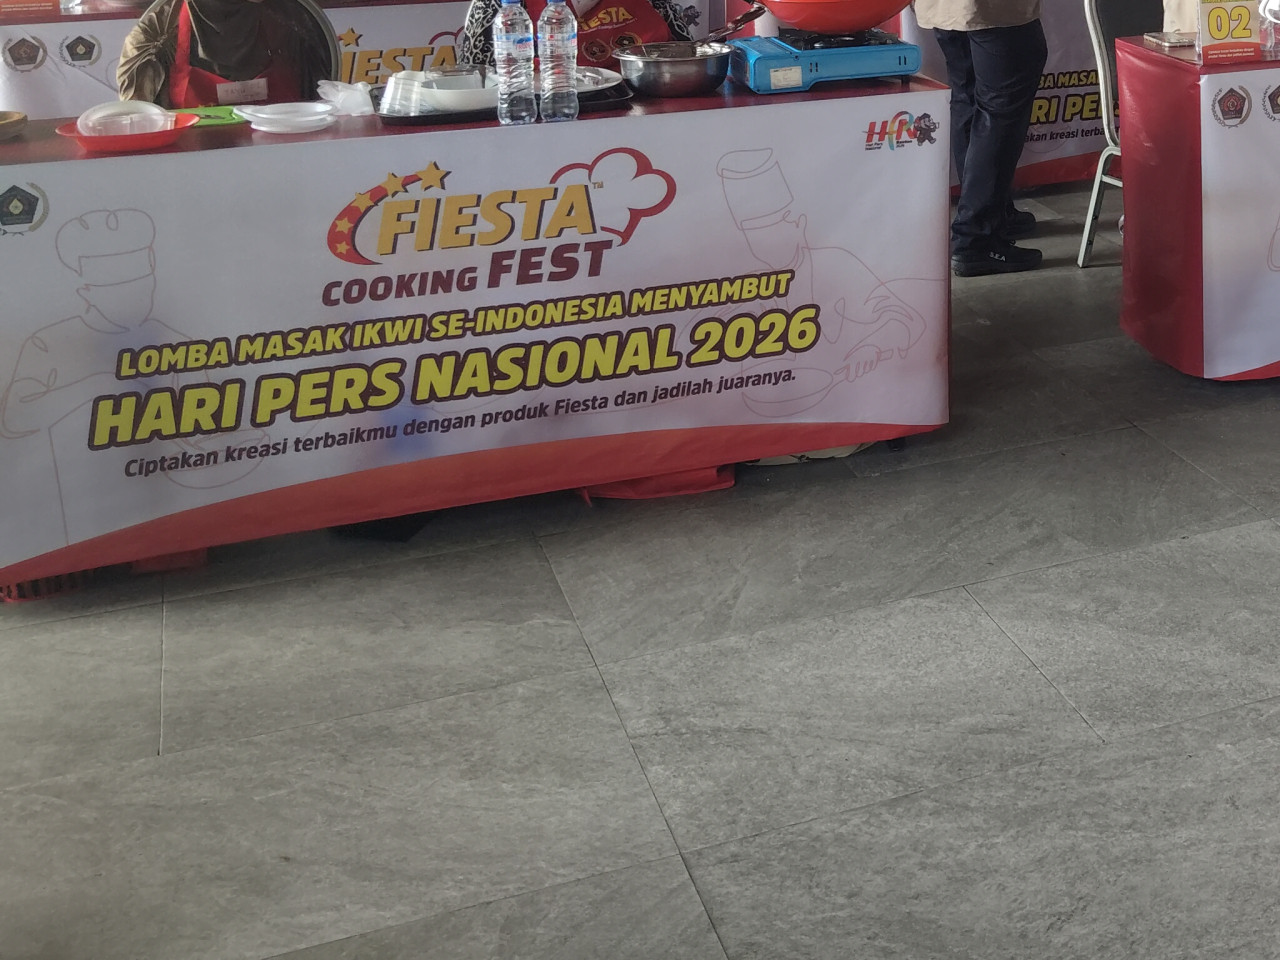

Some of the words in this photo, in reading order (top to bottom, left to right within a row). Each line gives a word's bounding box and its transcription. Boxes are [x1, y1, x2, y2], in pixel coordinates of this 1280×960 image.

[578, 7, 633, 31] IESTA
[1208, 5, 1252, 40] 02
[341, 45, 458, 85] IESTA
[1057, 69, 1100, 88] MASA
[1029, 94, 1060, 126] RI
[1025, 132, 1047, 143] akan
[1049, 128, 1079, 141] kreasi
[376, 183, 598, 257] FIESTA
[322, 266, 478, 307] COOKING
[487, 240, 613, 288] FEST
[117, 339, 234, 380] LOMBA
[235, 323, 349, 364] MASAK
[350, 314, 427, 349] IKWI
[427, 290, 626, 343] SE-INDONESIA
[627, 270, 795, 316] MENYAMBUT
[89, 378, 245, 450] HARI
[251, 357, 406, 428] PERS
[411, 324, 683, 407] NASIONAL
[680, 304, 820, 369] 2026
[125, 450, 218, 478] Ciptakan
[224, 437, 289, 463] kreasi
[294, 422, 397, 453] terbaikmu
[403, 414, 476, 439] dengan
[481, 401, 549, 428] produk
[554, 394, 609, 416] Fiesta
[614, 388, 648, 408] dan
[650, 378, 714, 404] jadilah
[716, 369, 796, 395] juaranya.
